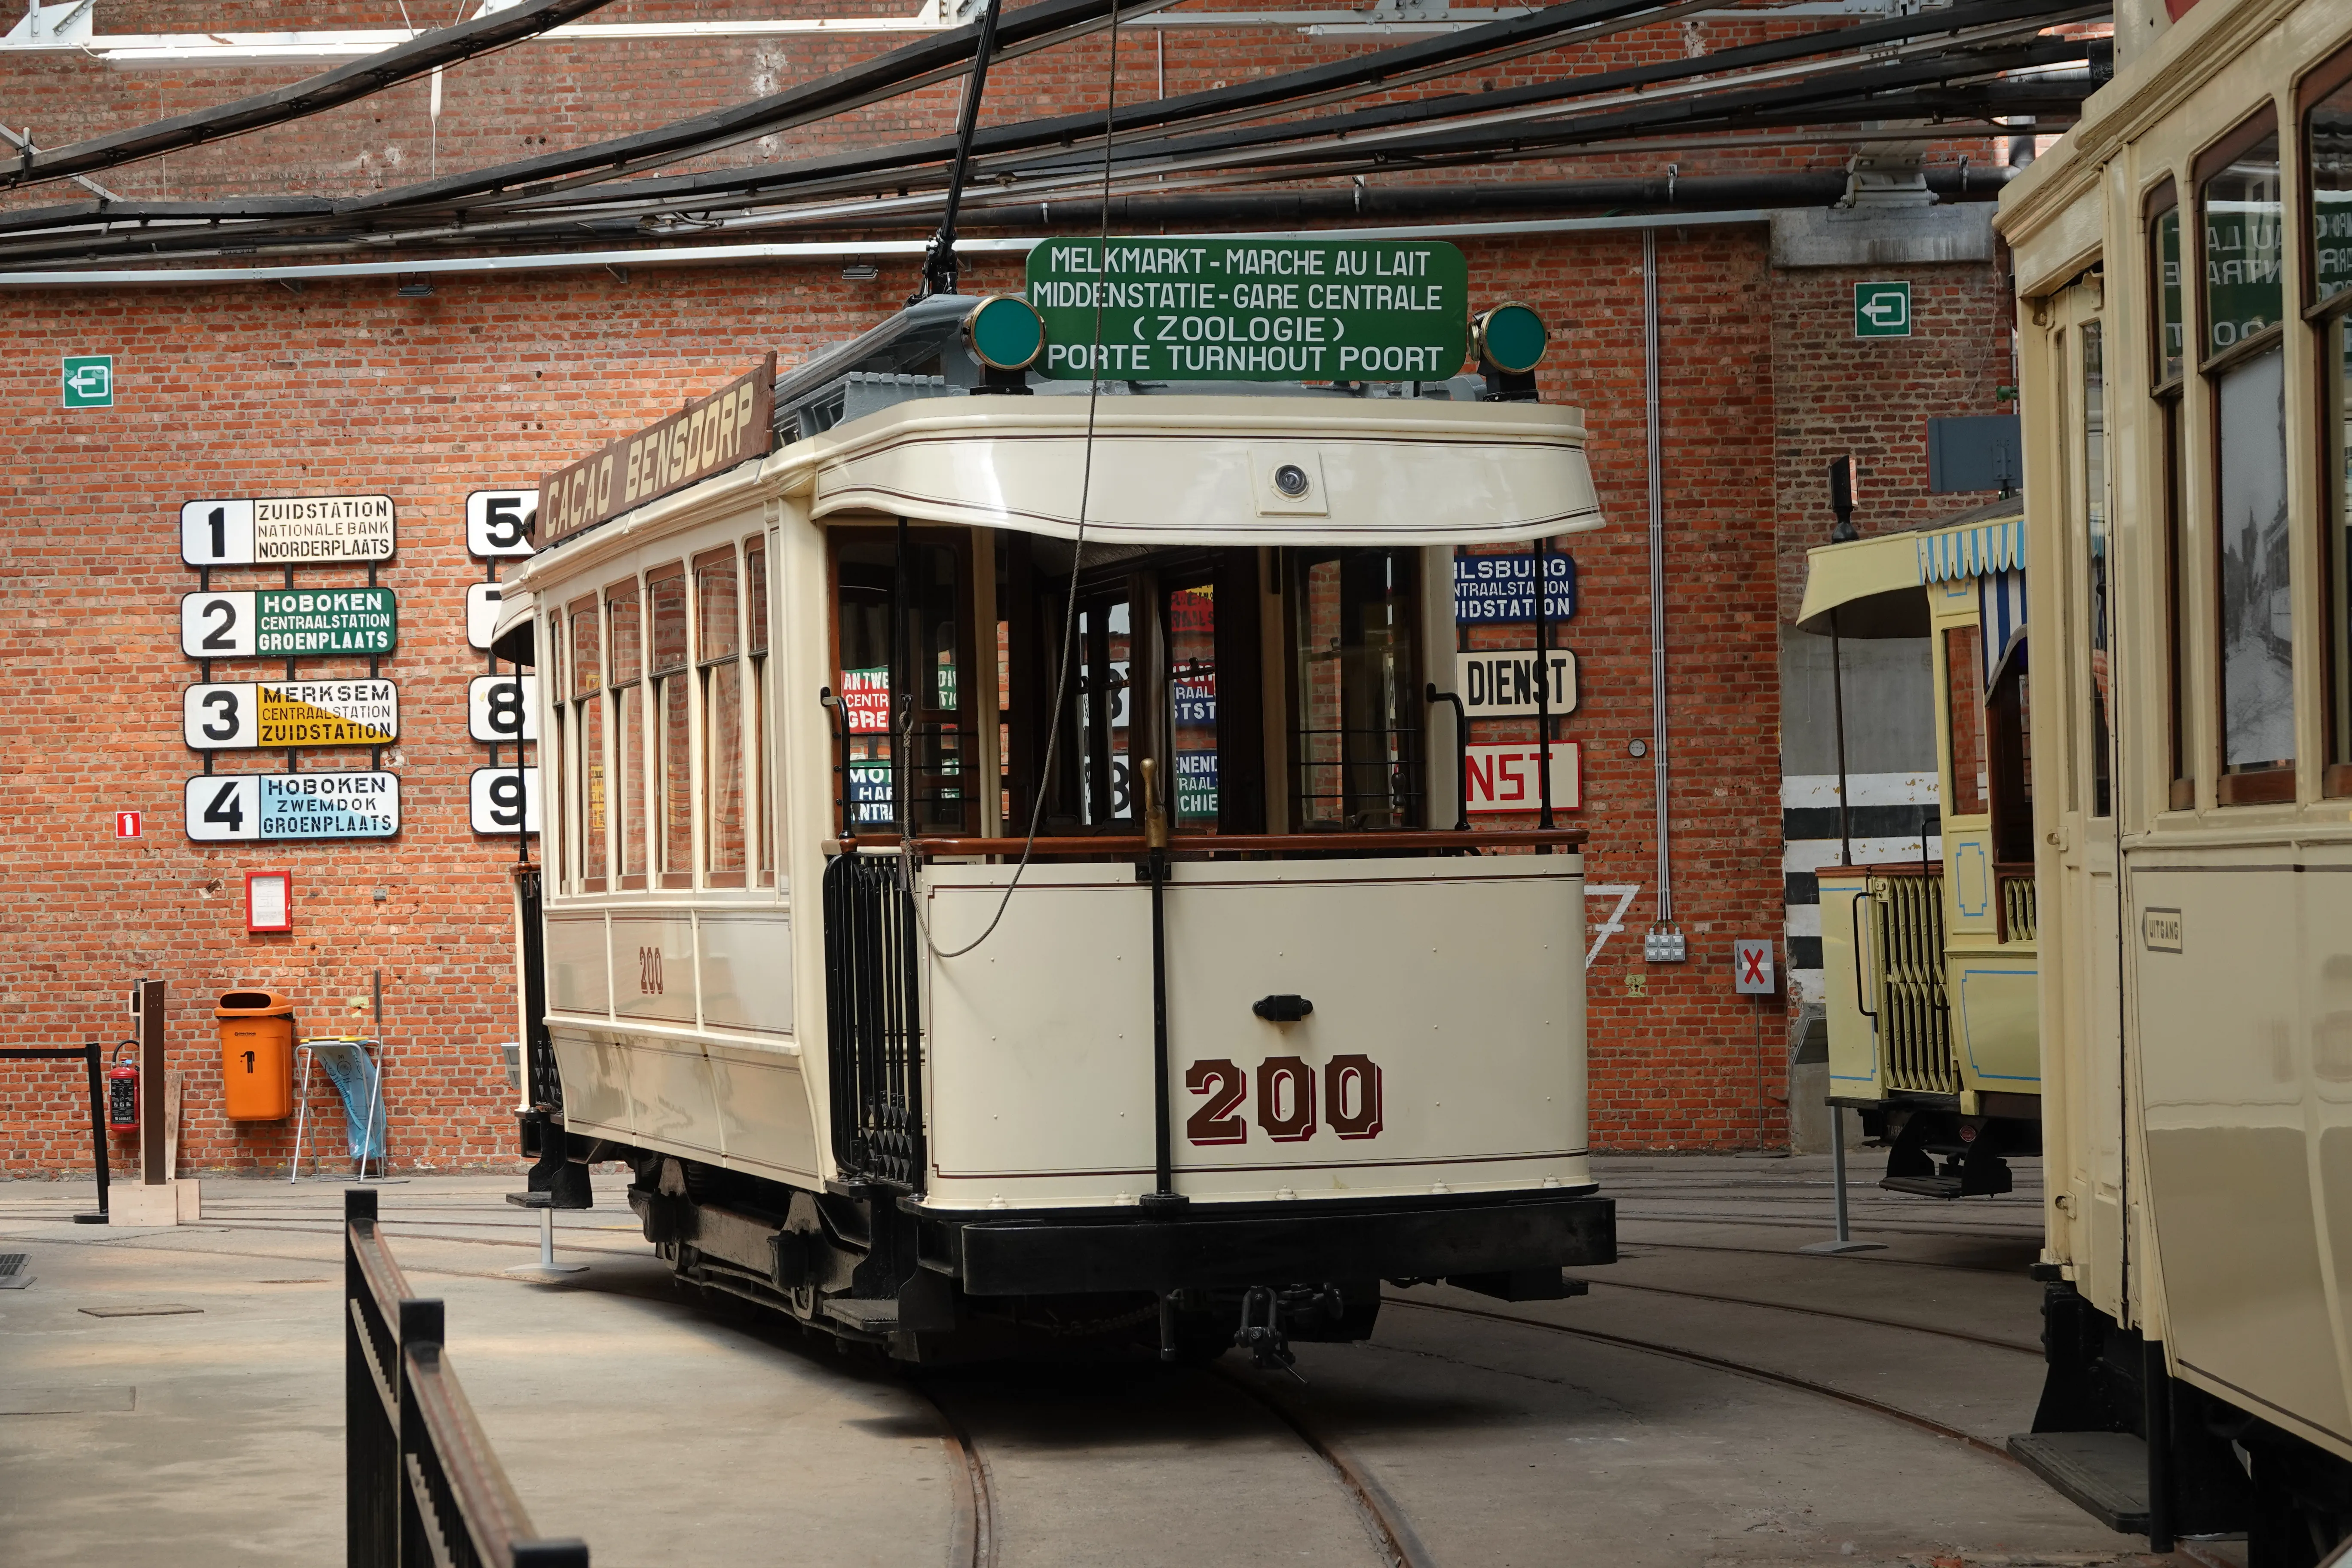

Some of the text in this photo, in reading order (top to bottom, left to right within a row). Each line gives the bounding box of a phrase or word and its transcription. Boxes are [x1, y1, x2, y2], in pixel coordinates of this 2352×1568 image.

[1226, 248, 1325, 276] MARCHE
[1335, 250, 1368, 276] AU
[1376, 251, 1431, 276] LAIT
[1234, 284, 1298, 309] GARE
[1308, 285, 1442, 310] CENTRALE
[1048, 344, 1443, 372] PORTE TURNHOUT POORT
[545, 381, 753, 538] CACAO BENSDORP
[258, 502, 388, 521] ZUIDSTATION
[208, 507, 225, 557] 1
[258, 521, 389, 537] NATIONALE BANK
[486, 498, 521, 548] 5
[259, 539, 389, 558] NOORDERPLAATS
[1455, 580, 1568, 597] NTRAALSTAION
[264, 593, 382, 613] HOBOKEN
[1455, 597, 1569, 618] IDSTATON
[202, 600, 236, 649] 2
[261, 614, 390, 630] CENTRAALSTATION
[259, 631, 388, 651] GROENPLAATS
[263, 685, 390, 703] MERKSEM
[202, 691, 239, 741] 3
[262, 706, 390, 720] CENTRAALSTATION
[487, 683, 525, 734] 8
[262, 723, 391, 741] ZUIDSTATION
[268, 777, 386, 796] HOBOKEN
[1466, 753, 1553, 802] NST
[204, 781, 243, 832] 4
[277, 798, 377, 812] ZWEMDOK
[490, 775, 525, 826] 9
[263, 815, 392, 833] GROENPLAATS
[2149, 919, 2178, 940] UITGANG
[640, 946, 663, 994] 200
[1185, 1054, 1383, 1146] 200
